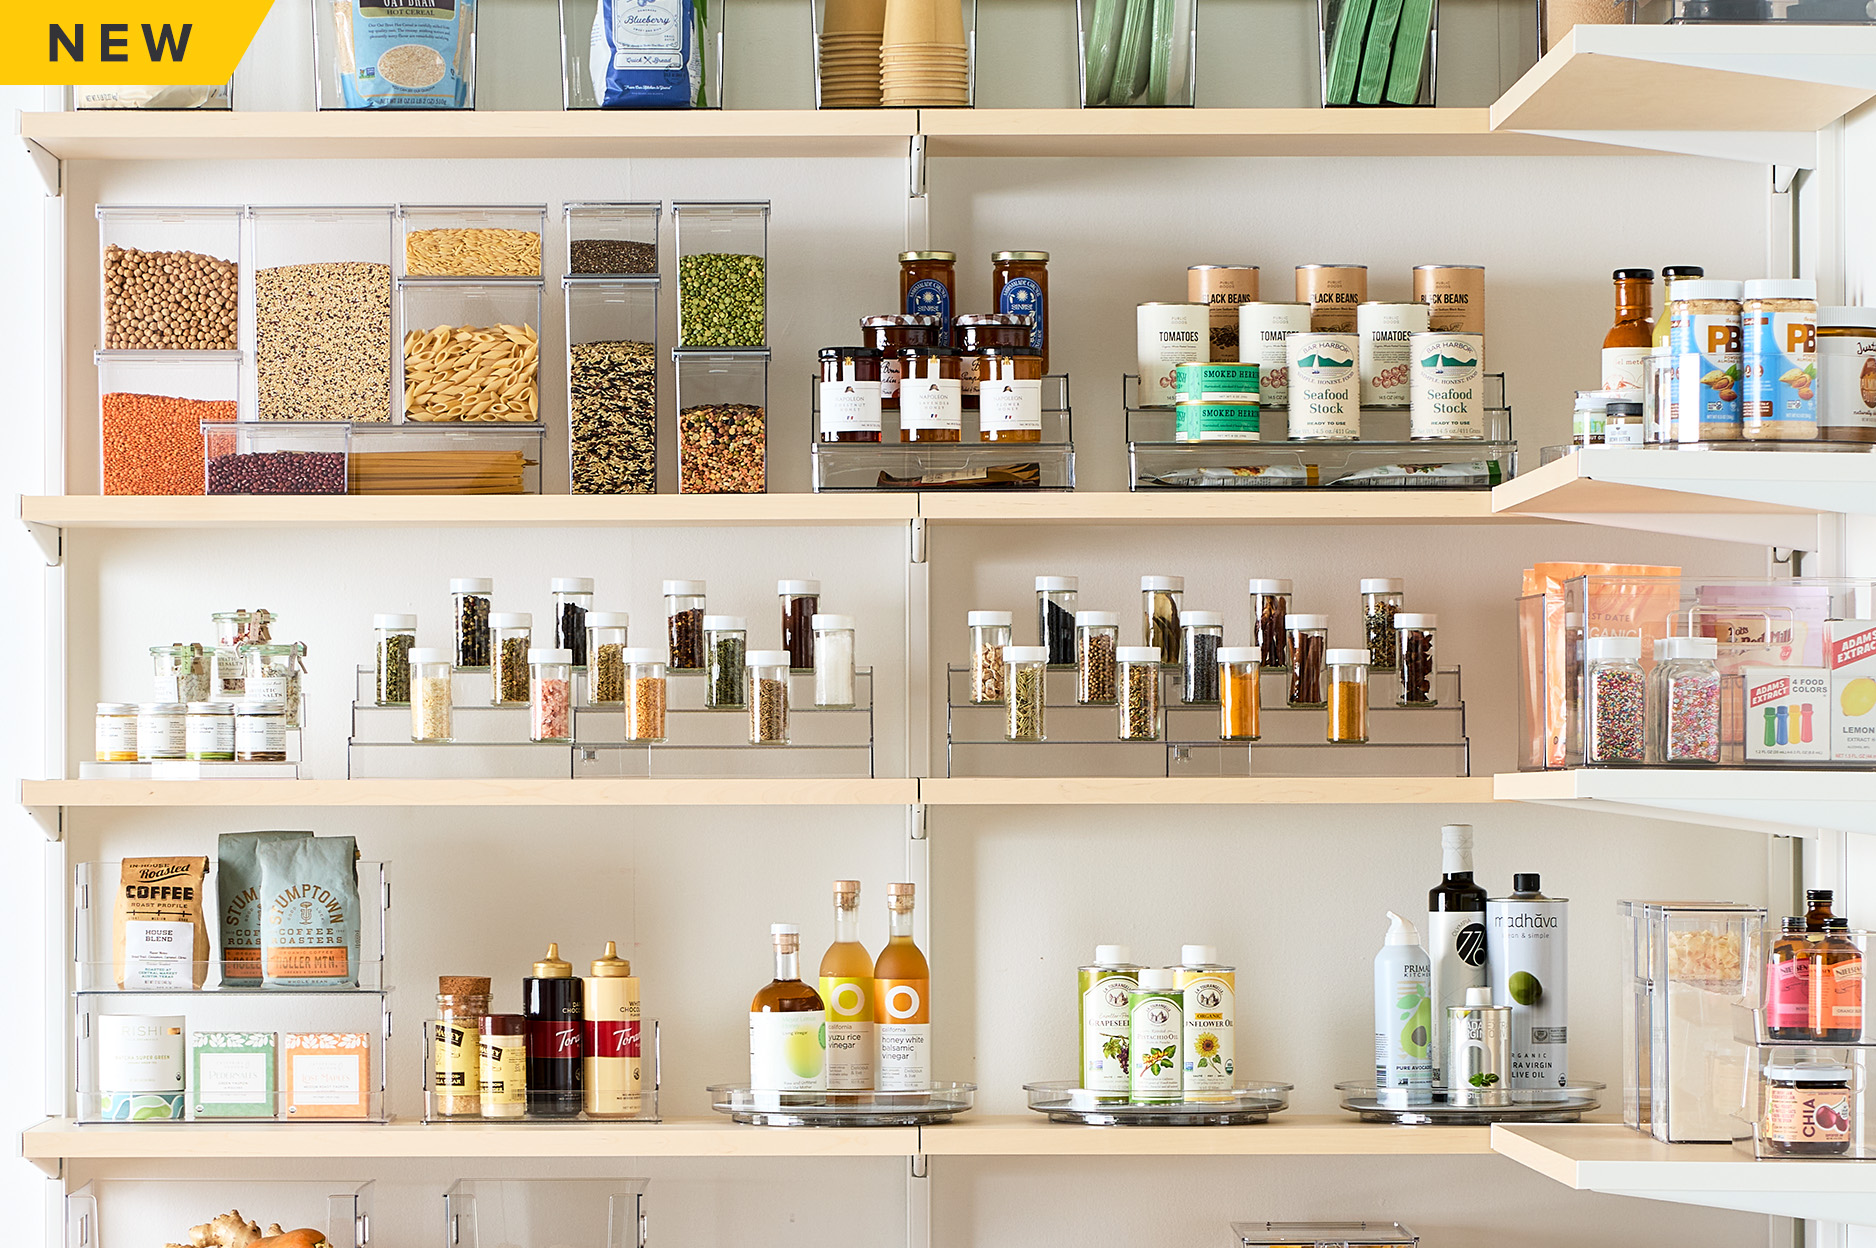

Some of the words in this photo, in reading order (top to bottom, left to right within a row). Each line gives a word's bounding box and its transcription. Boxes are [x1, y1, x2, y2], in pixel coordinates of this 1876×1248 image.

[624, 15, 671, 25] Blueberry
[626, 56, 642, 64] Quick
[1228, 293, 1251, 304] BEANS
[1311, 293, 1334, 303] LACK
[1335, 293, 1359, 303] BEANS
[1420, 294, 1442, 304] BLCK
[1444, 293, 1469, 304] BEANS
[1159, 331, 1199, 342] TOMATOES
[1371, 331, 1412, 342] TOMATOES
[1303, 343, 1317, 354] BAR
[1319, 342, 1350, 354] HARBOR
[1426, 343, 1441, 354] BAR
[1442, 342, 1473, 354] HARBOR
[1203, 370, 1237, 378] SMOKED
[1303, 388, 1349, 401] Seafood
[1427, 388, 1473, 400] Seafood
[1202, 409, 1236, 417] SMOKED
[1309, 402, 1344, 414] Stock
[1433, 402, 1468, 414] Stock
[1604, 613, 1630, 623] DATE
[1589, 626, 1637, 638] GANIC
[1770, 628, 1792, 642] Mill
[1841, 631, 1876, 652] ADAMS
[1837, 642, 1876, 664] EXTRAC
[1755, 680, 1785, 696] ADAMS
[1752, 686, 1789, 705] EXTRACT
[1842, 726, 1875, 734] LEMON
[139, 864, 191, 879] Roasted
[126, 885, 194, 901] COFFEE
[269, 883, 344, 925] STUMPTOWN
[235, 929, 261, 937] COF
[271, 936, 343, 944] ROASTERS
[1457, 931, 1486, 966] 776
[276, 956, 310, 969] HOLLER
[314, 956, 338, 969] MTN.
[1780, 964, 1808, 973] NIESEN
[1088, 1019, 1130, 1027] GRAPESEE
[121, 1026, 162, 1036] RISHI
[555, 1028, 580, 1052] Tora
[612, 1027, 640, 1051] Tora
[828, 1034, 845, 1043] yuzu
[846, 1033, 862, 1041] rice
[881, 1036, 904, 1046] honey
[905, 1035, 925, 1044] white
[828, 1042, 856, 1051] vinegar
[881, 1044, 915, 1052] balsamic
[881, 1052, 910, 1061] vinegar
[1525, 1061, 1553, 1069] VIRGIN
[1511, 1071, 1529, 1079] LIVE
[1532, 1071, 1545, 1079] OIL
[1802, 1098, 1816, 1137] CHIA
